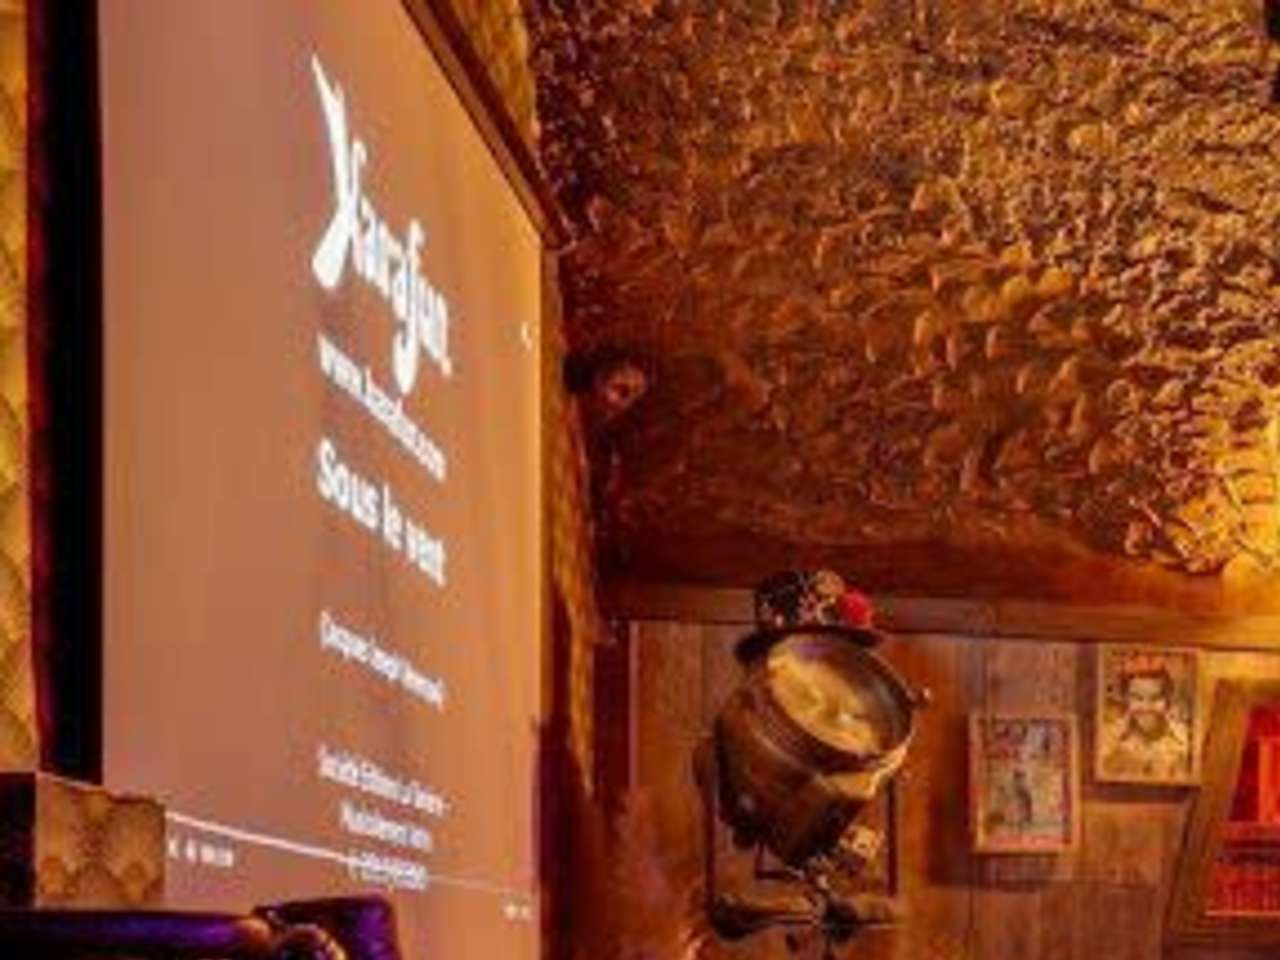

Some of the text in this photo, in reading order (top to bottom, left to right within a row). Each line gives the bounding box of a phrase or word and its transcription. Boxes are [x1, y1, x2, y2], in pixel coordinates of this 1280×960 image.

[316, 437, 447, 587] Sous le vent
